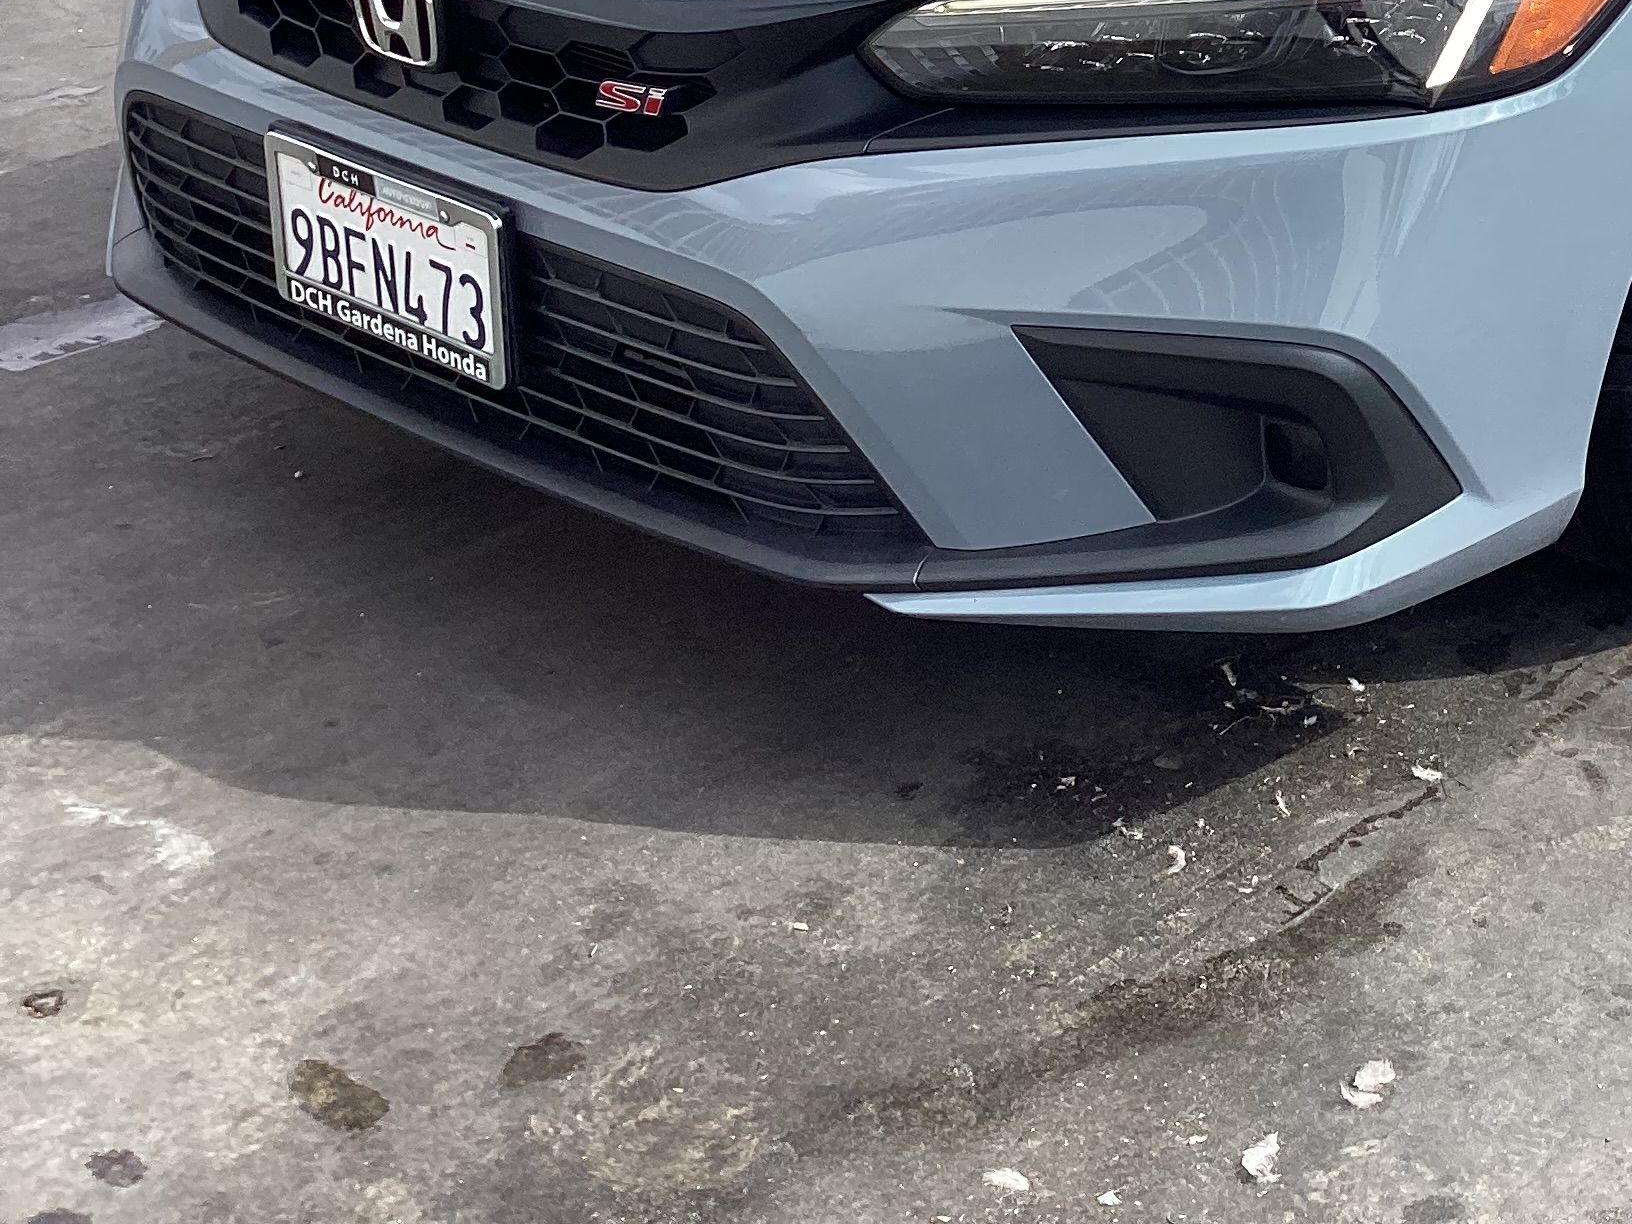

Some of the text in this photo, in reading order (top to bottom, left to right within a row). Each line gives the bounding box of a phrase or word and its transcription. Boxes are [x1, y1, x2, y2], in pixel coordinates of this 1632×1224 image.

[594, 80, 668, 116] Si
[332, 166, 359, 185] DCH
[318, 176, 456, 251] California
[290, 280, 487, 380] DCH Gardena Honda
